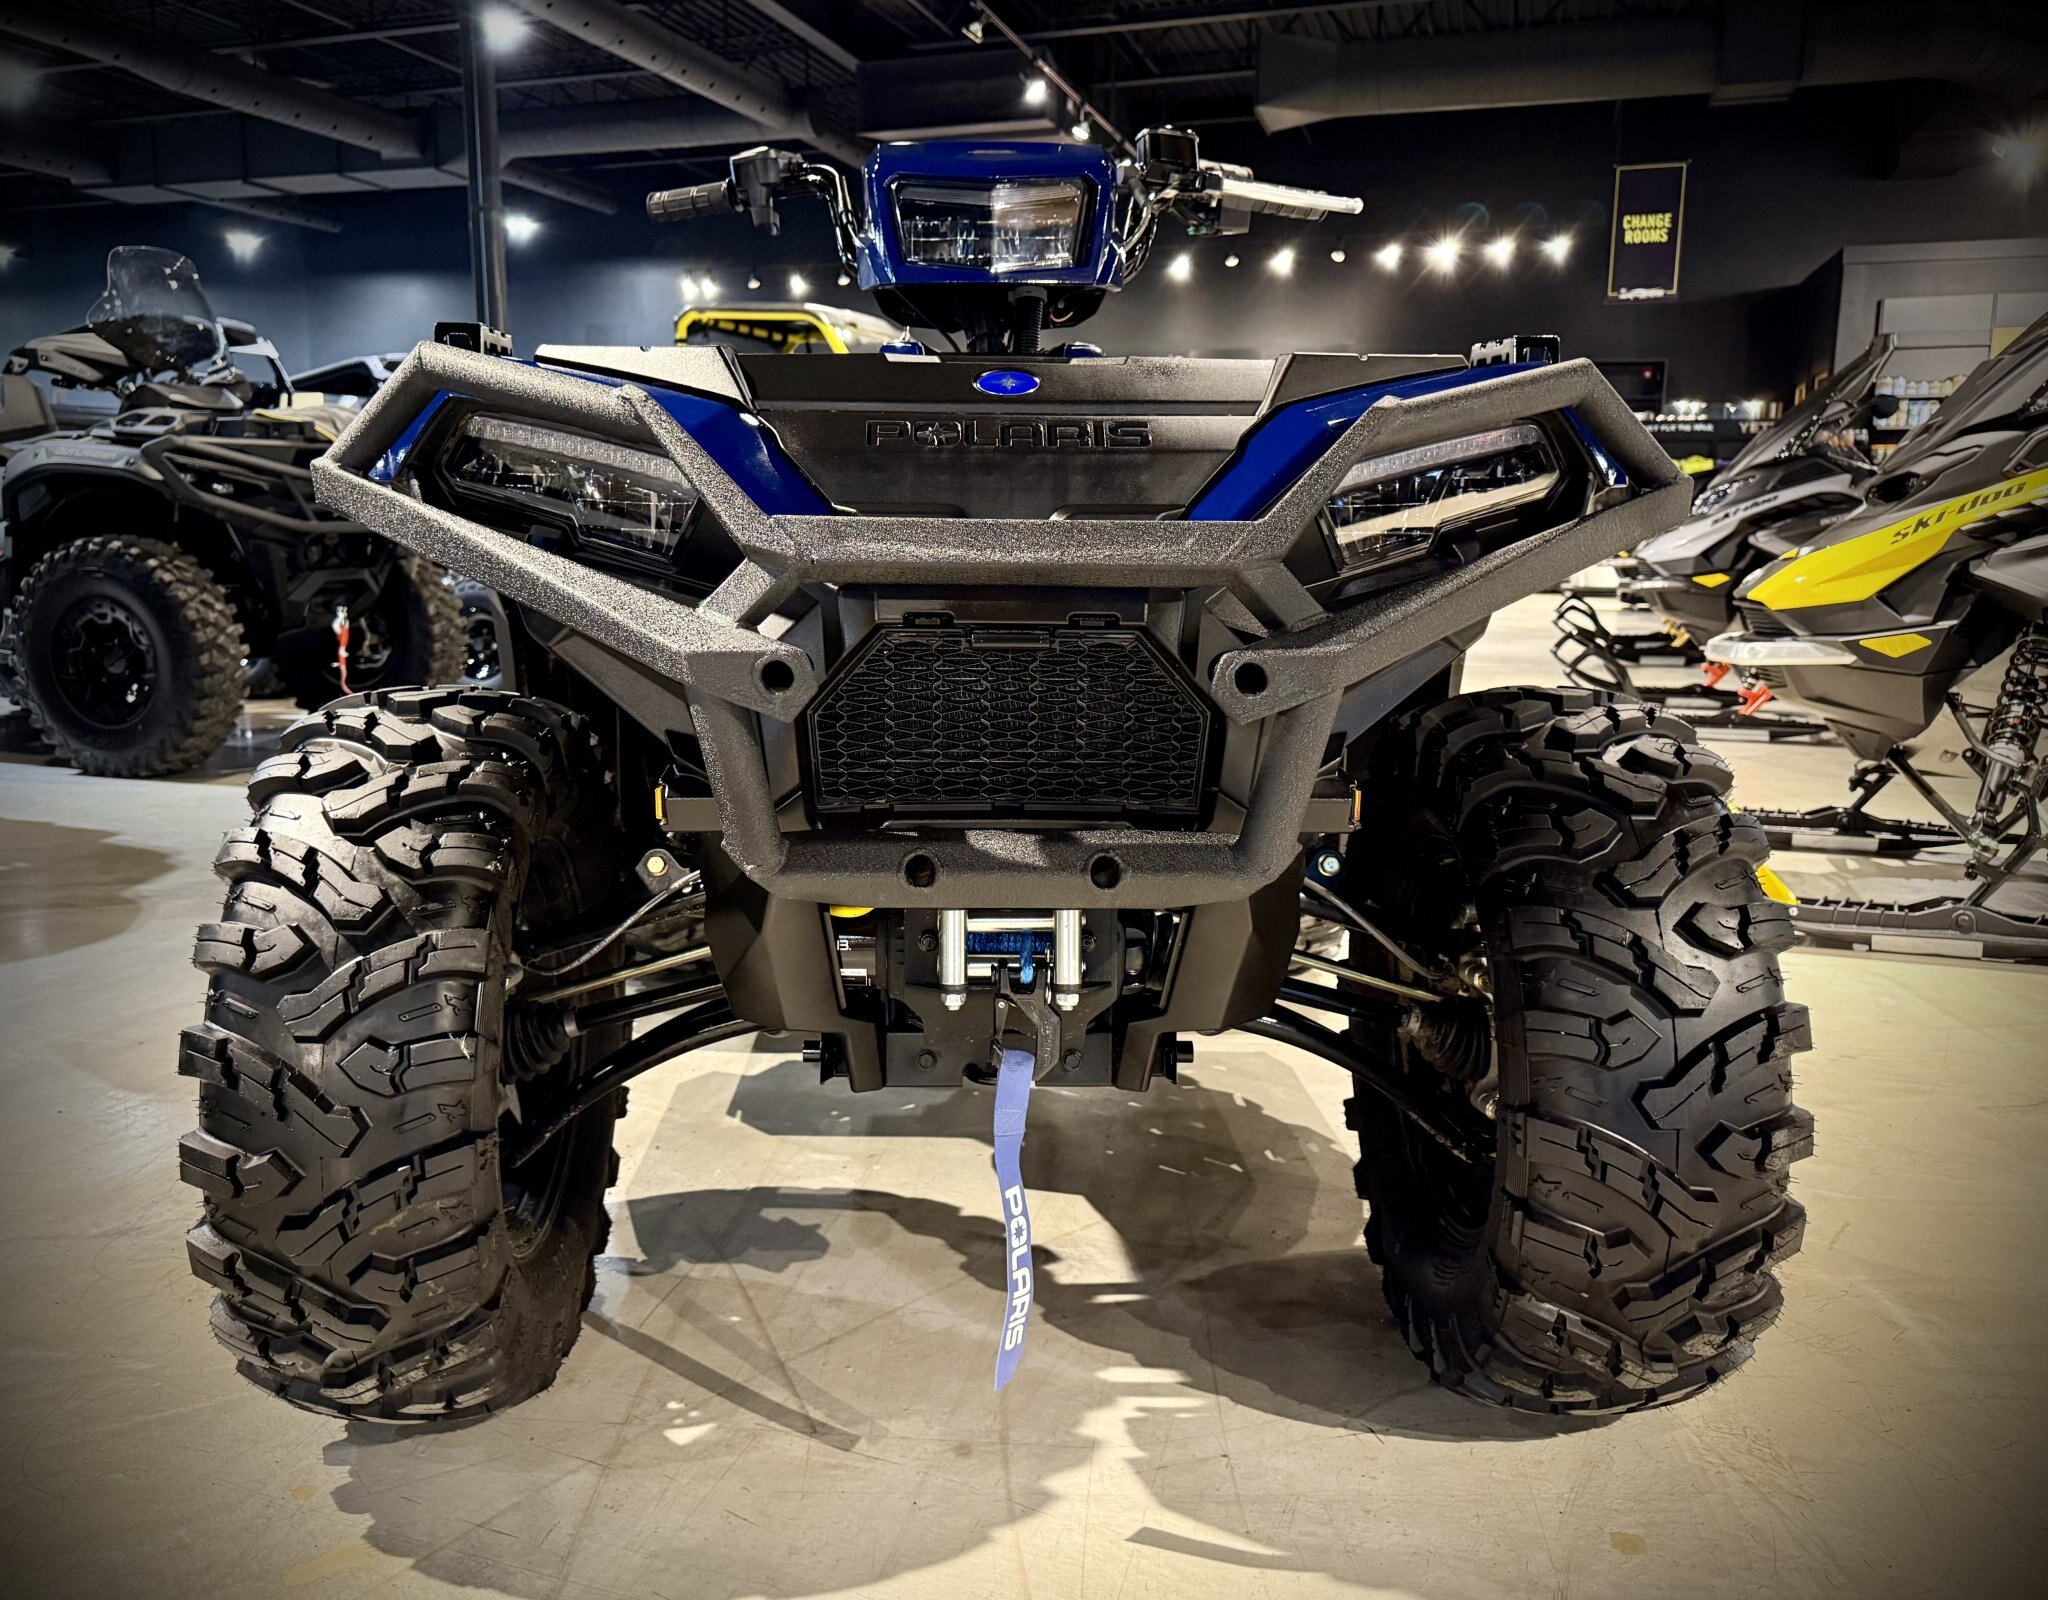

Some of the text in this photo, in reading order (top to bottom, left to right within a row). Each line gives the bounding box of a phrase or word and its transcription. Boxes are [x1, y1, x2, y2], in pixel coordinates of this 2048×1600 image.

[1623, 213, 1672, 230] CHANGE
[1624, 228, 1669, 245] ROOMS
[865, 419, 1153, 448] POLARIS
[1004, 1184, 1032, 1351] POLARIS
